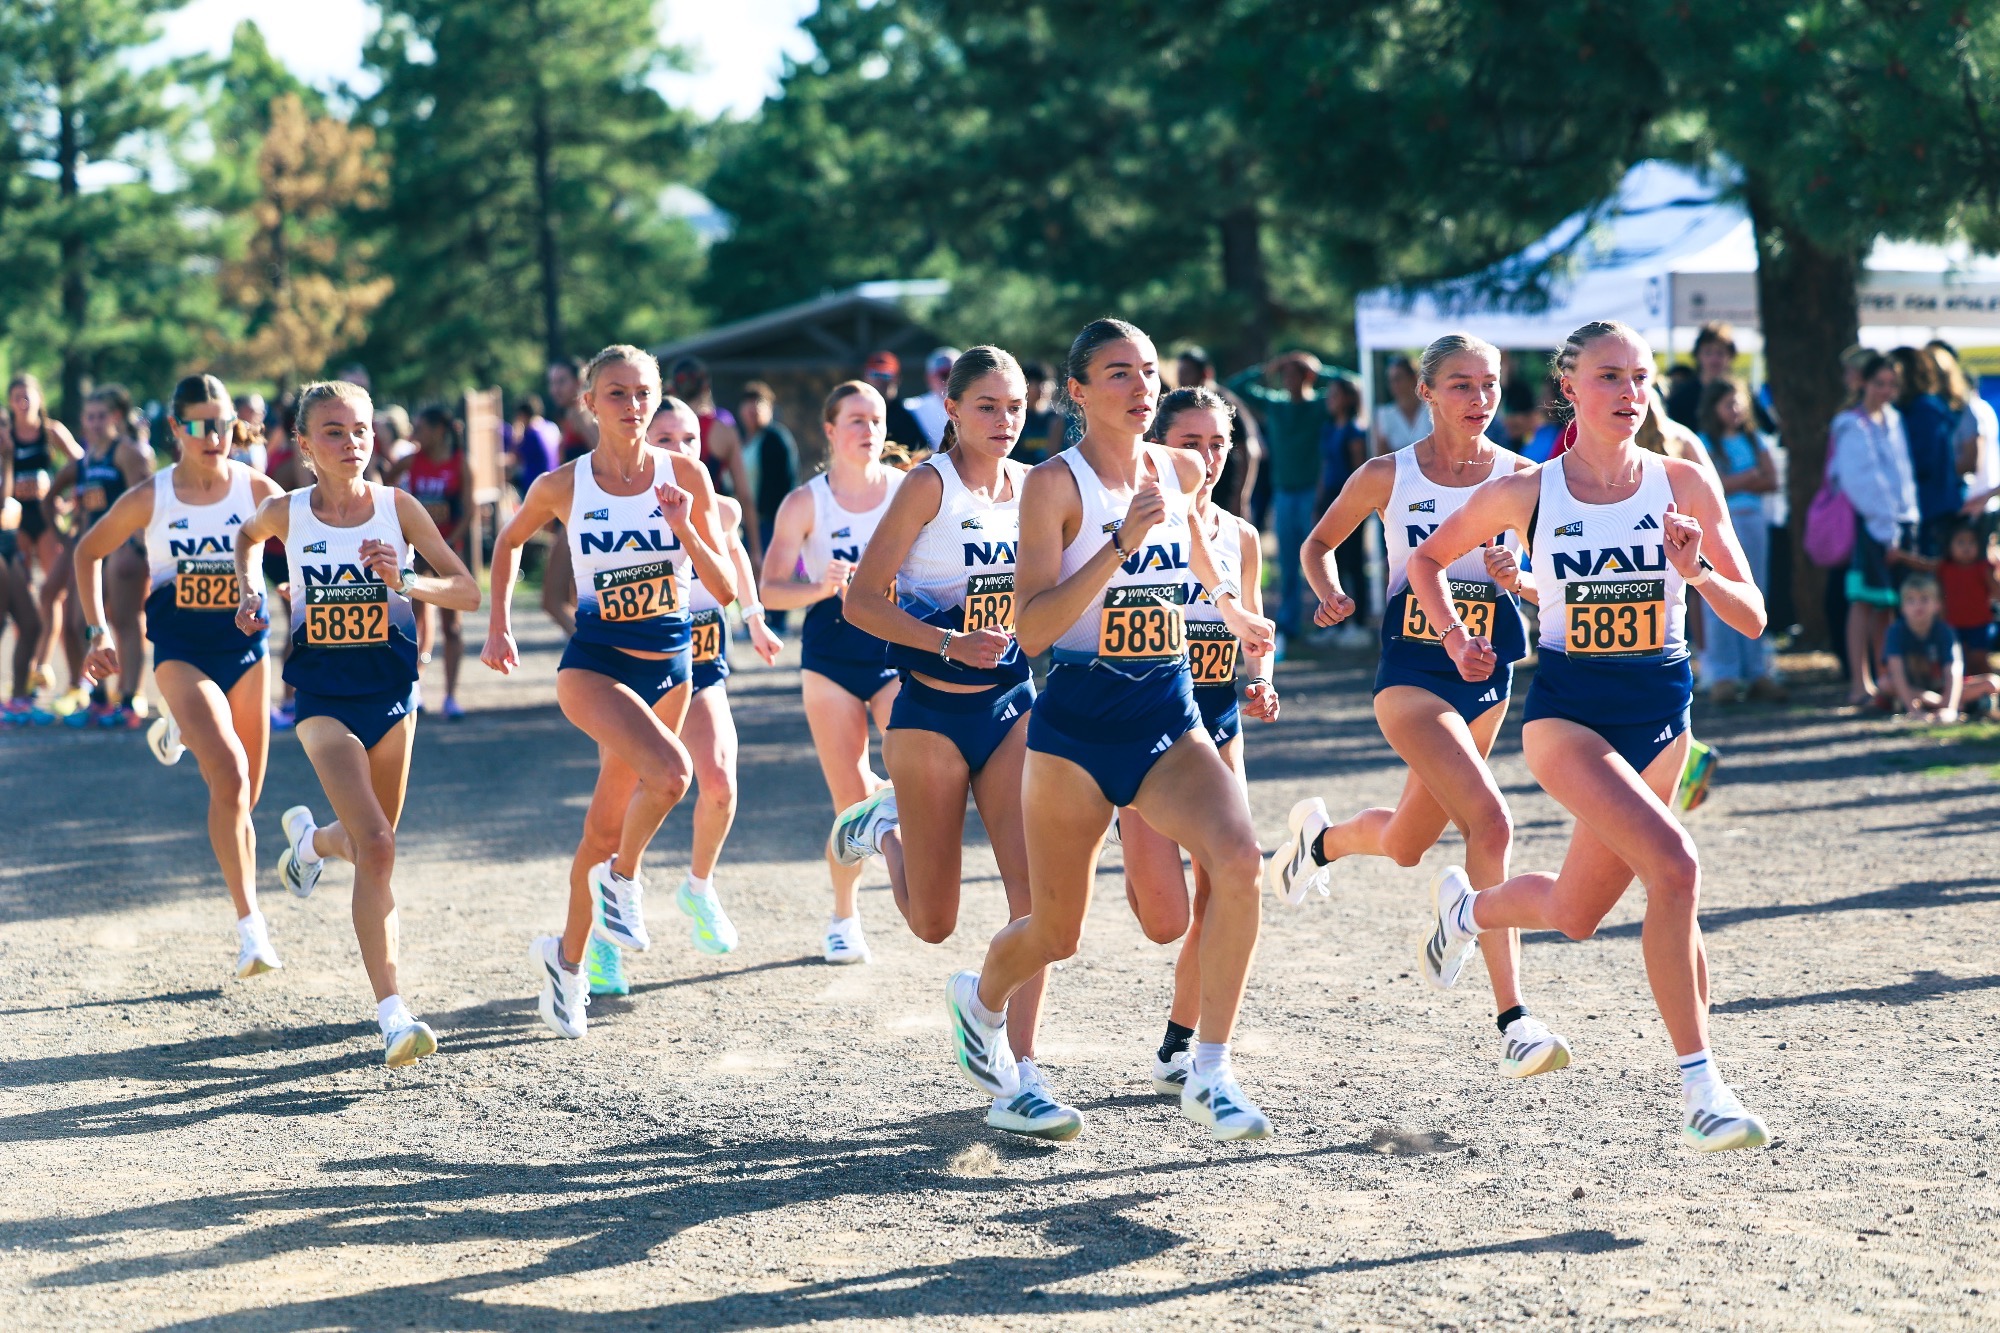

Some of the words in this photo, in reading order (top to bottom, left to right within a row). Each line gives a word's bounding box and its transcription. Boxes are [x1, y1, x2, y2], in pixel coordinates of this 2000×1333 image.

[580, 529, 682, 555] NAU
[963, 541, 1019, 567] NA
[613, 563, 664, 579] WINGFOOT
[1551, 544, 1668, 580] NAU
[180, 576, 241, 606] 5828
[326, 586, 378, 597] WINGFOOT
[601, 578, 676, 621] 5824
[1128, 585, 1176, 598] WINGFOOT
[1448, 582, 1488, 594] GFOOT
[1591, 582, 1655, 595] WINGFOOT
[1593, 592, 1653, 600] FINISH
[310, 605, 384, 641] 5832
[968, 595, 1016, 633] 582
[1571, 603, 1657, 649] 5831
[1105, 609, 1181, 653] 5830
[1188, 642, 1234, 680] 829
